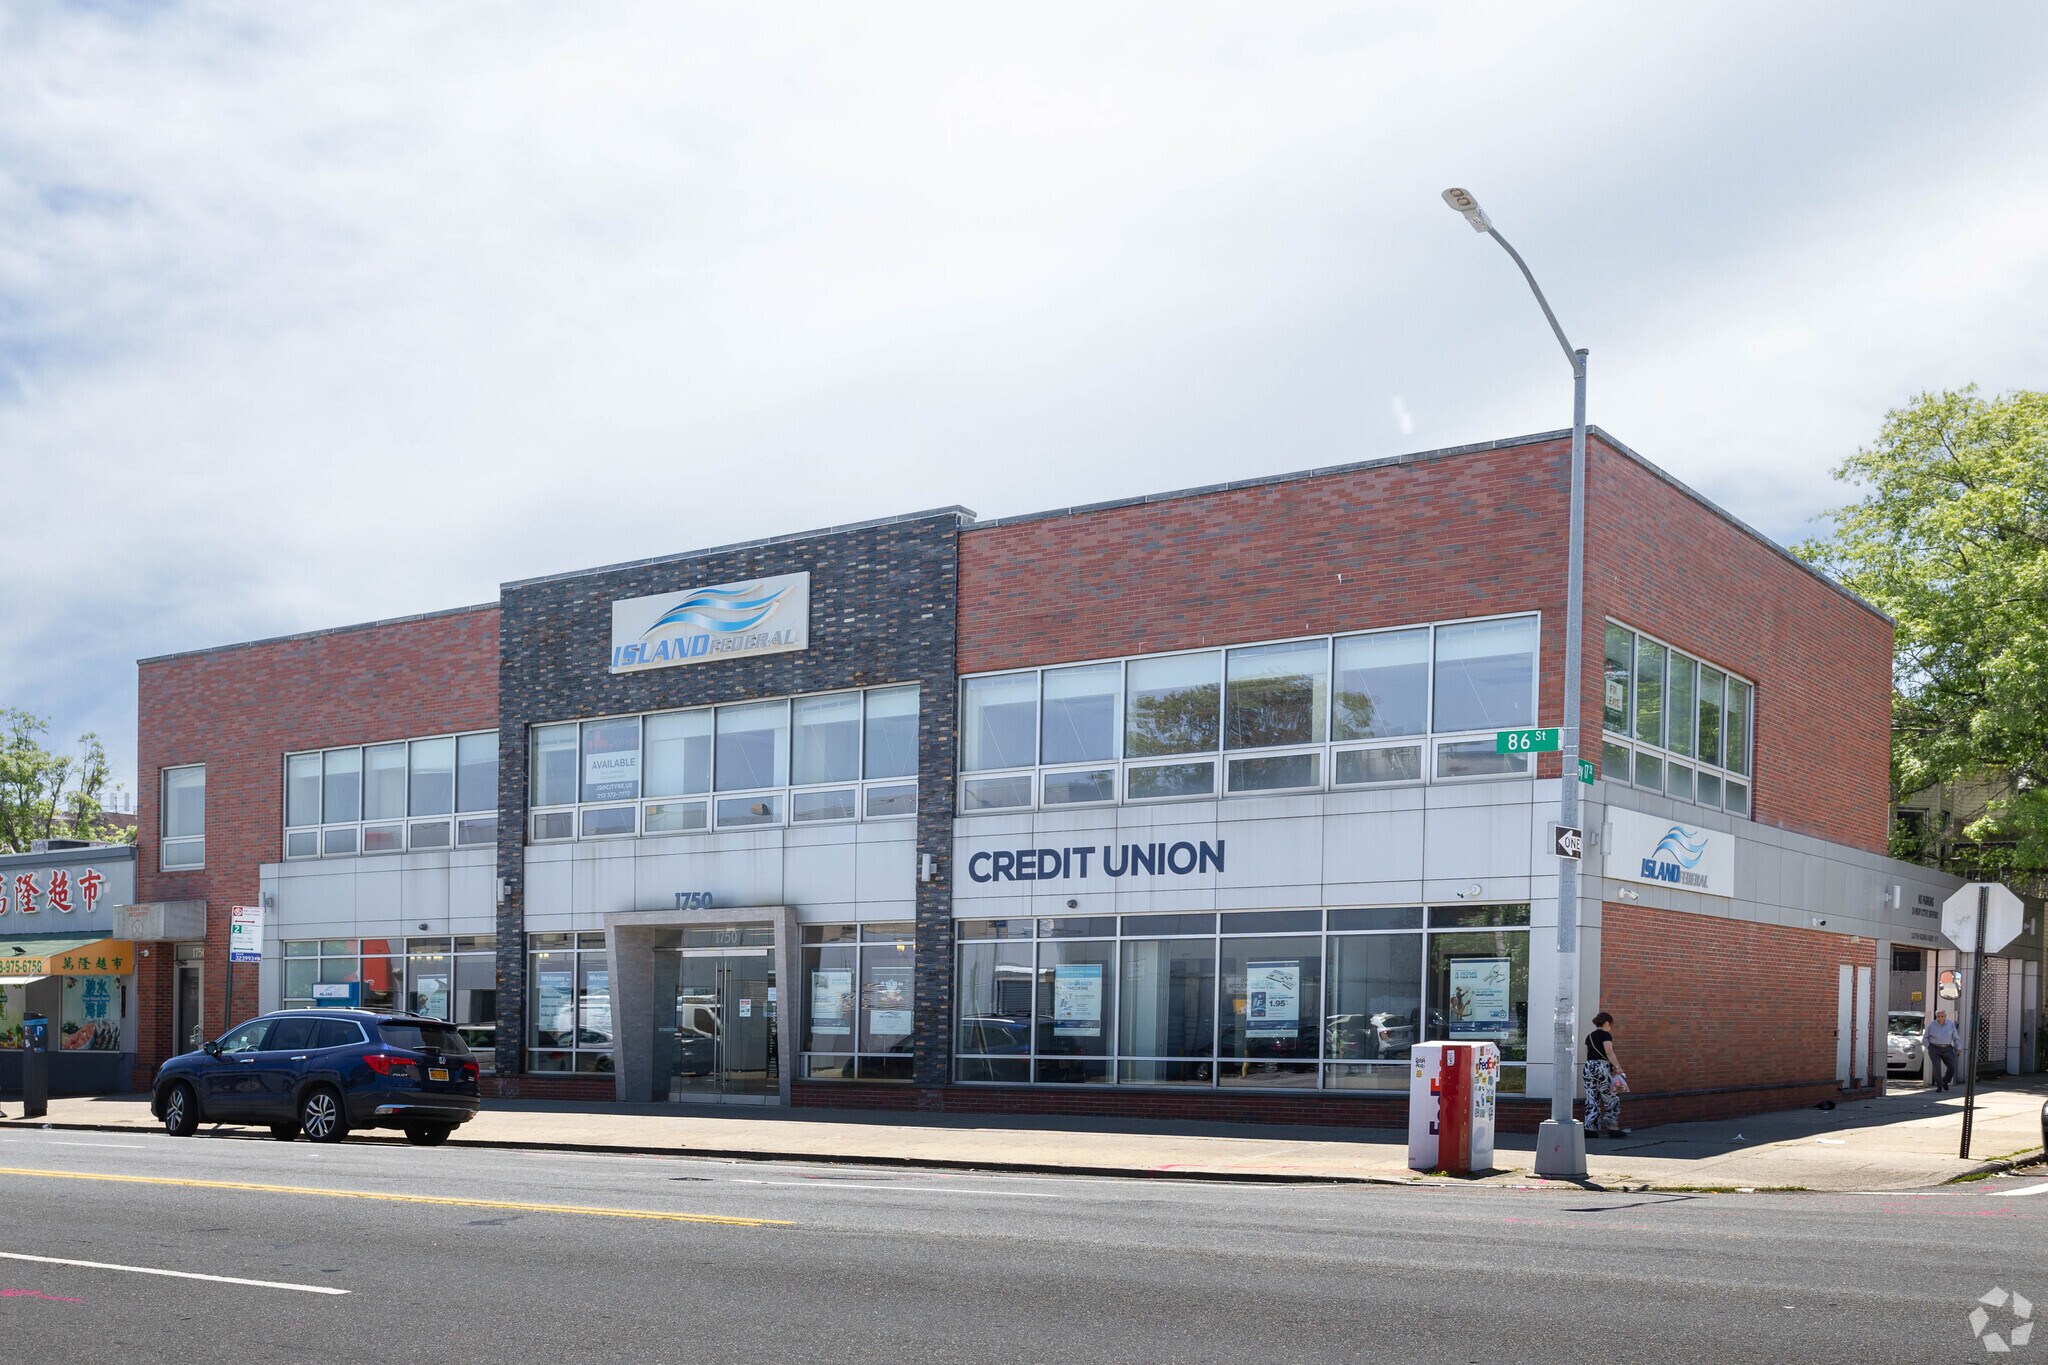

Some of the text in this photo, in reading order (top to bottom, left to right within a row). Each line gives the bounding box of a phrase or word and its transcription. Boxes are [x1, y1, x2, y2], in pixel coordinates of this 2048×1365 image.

[612, 633, 710, 668] ISLAND
[1508, 731, 1546, 751] 86 St
[592, 757, 636, 770] AVAILABLE
[1564, 837, 1581, 851] ONE
[968, 840, 1226, 883] CREDIT UNION
[674, 891, 713, 911] 1750
[715, 931, 738, 944] 1750
[36, 1026, 43, 1036] P
[1479, 1057, 1495, 1070] FedEx
